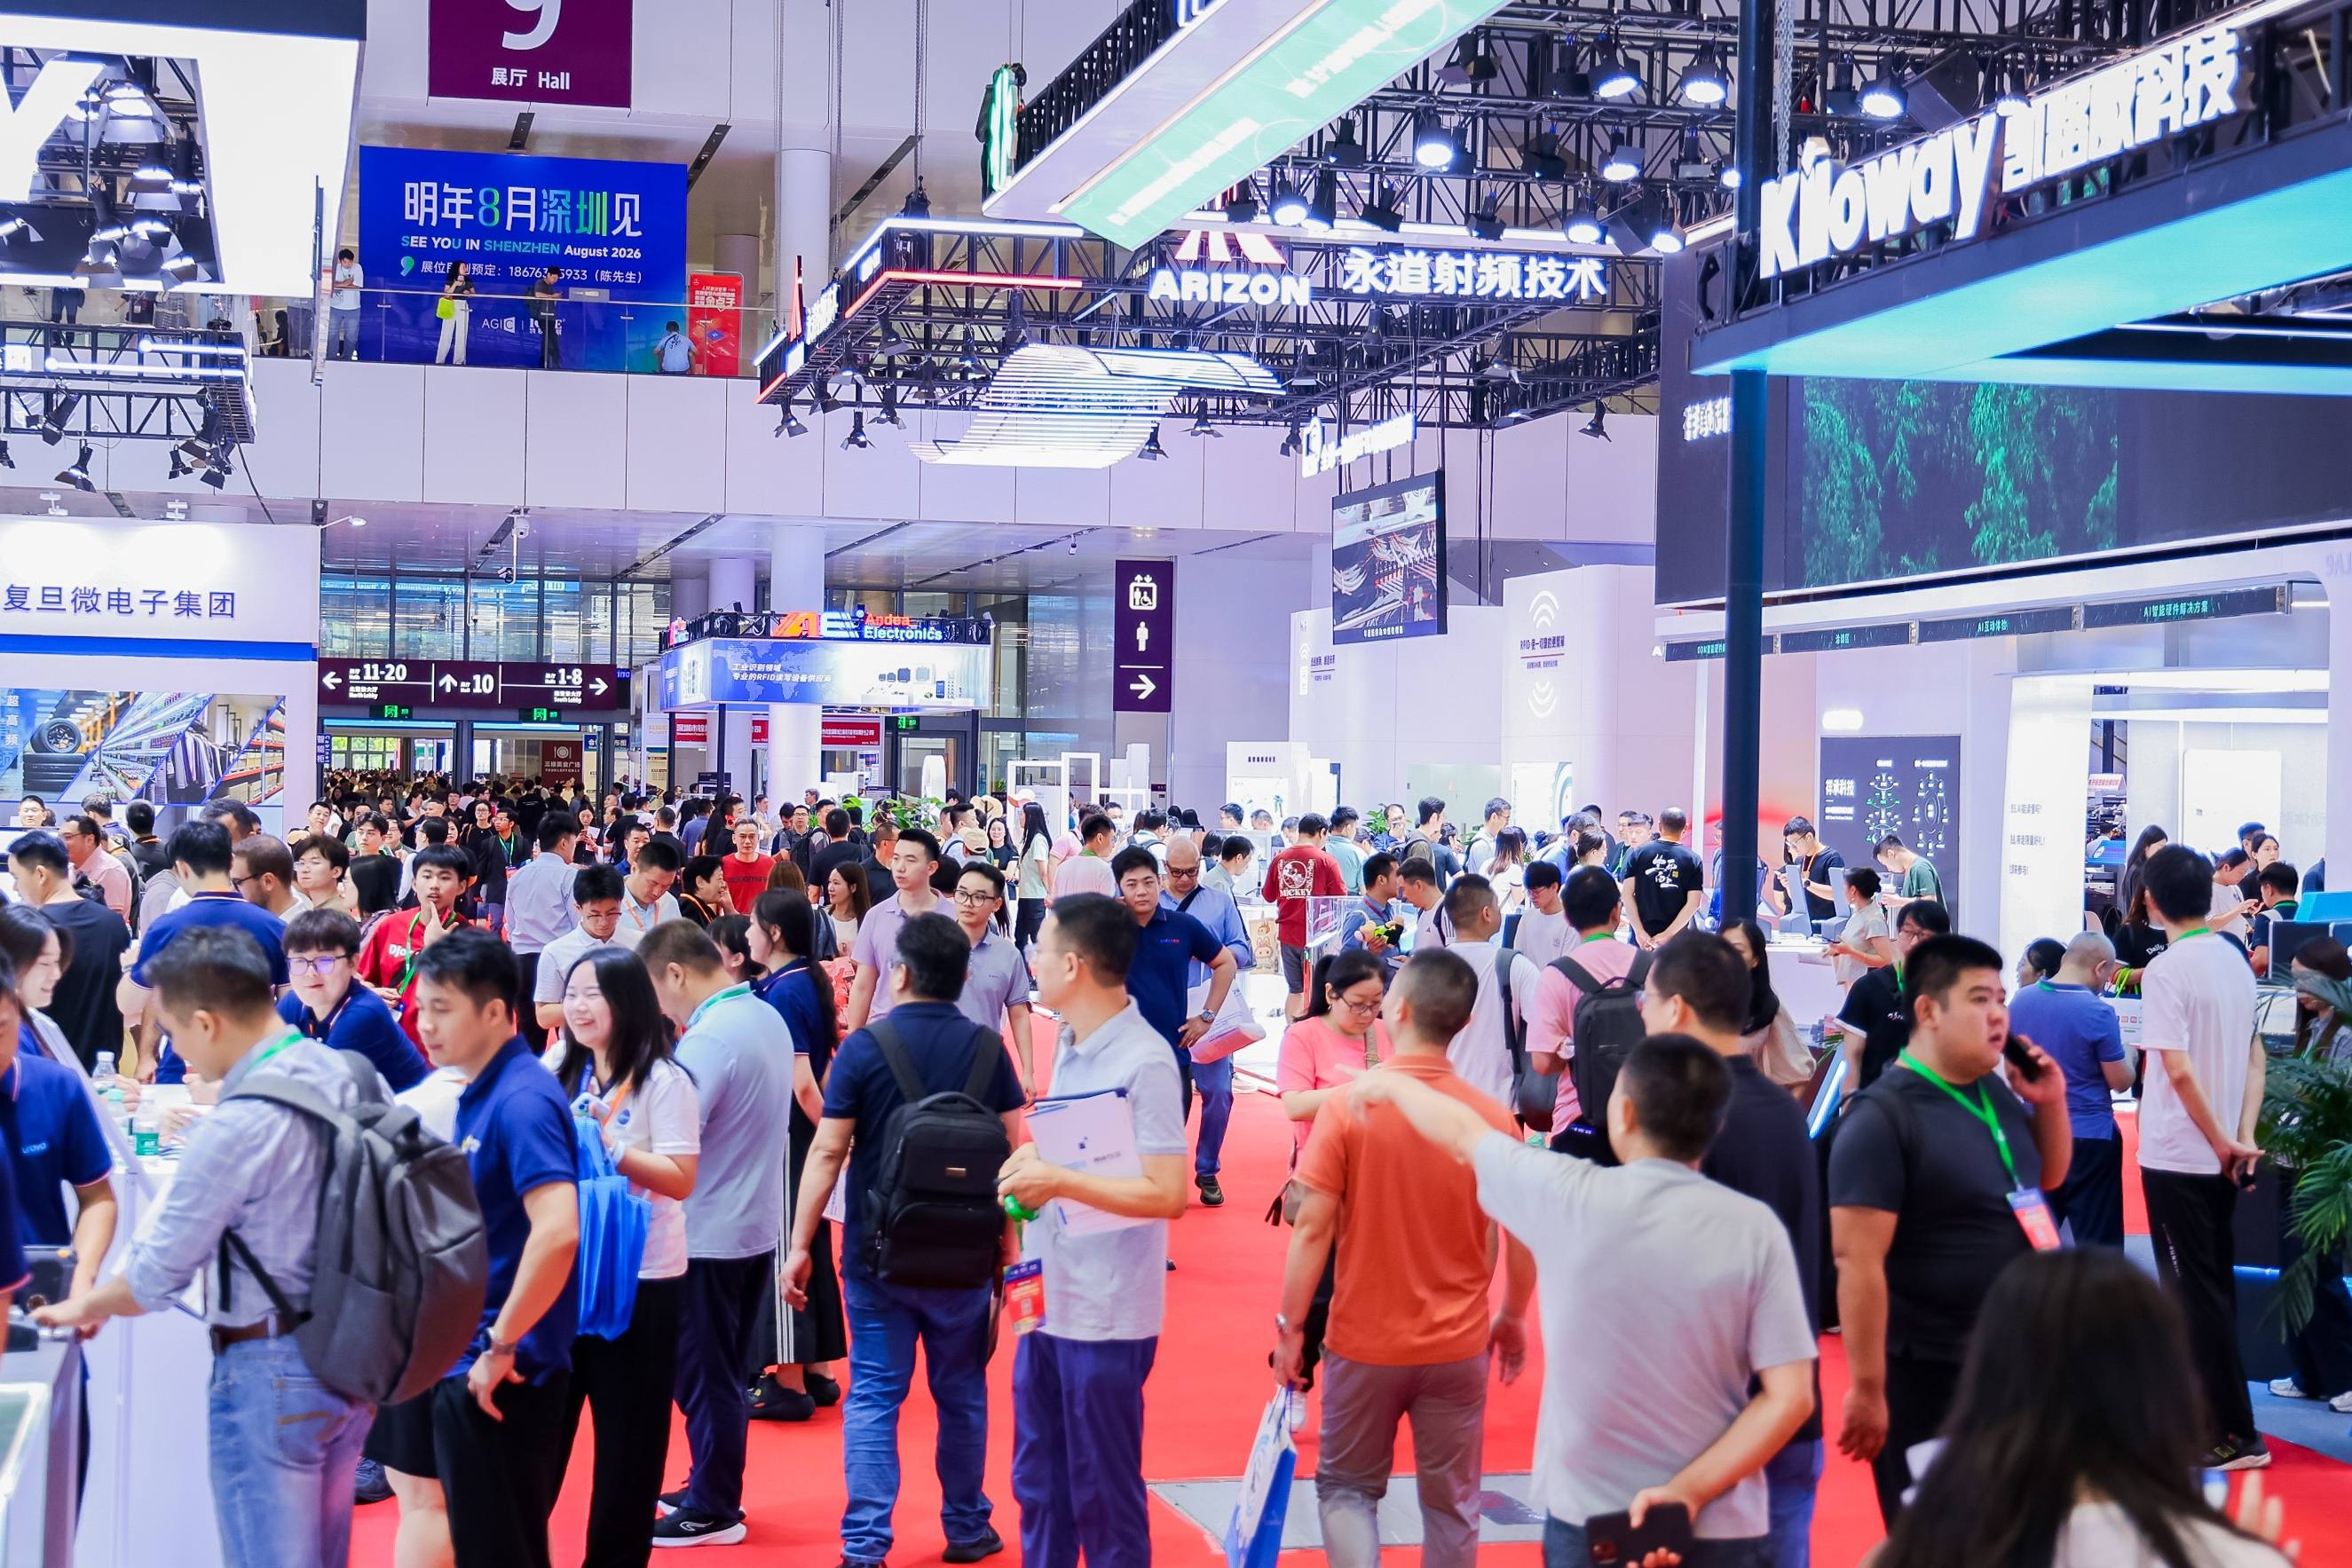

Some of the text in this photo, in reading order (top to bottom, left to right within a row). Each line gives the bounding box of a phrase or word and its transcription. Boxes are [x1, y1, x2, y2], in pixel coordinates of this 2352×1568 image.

[491, 67, 570, 90] 展厅 Hall
[404, 181, 643, 238] 明年8月深圳见
[401, 235, 642, 259] SEE YOU IN SHENZHEN August 2026
[509, 265, 588, 280] 1867635933
[1342, 247, 1608, 300] 永道射频技术
[1149, 269, 1311, 306] ARIZON
[3, 583, 236, 619] 复旦微电子集团
[864, 613, 911, 626] Andea
[864, 627, 943, 641] Electronics
[363, 663, 407, 681] 11-20
[558, 668, 583, 685] 1-8
[472, 674, 494, 694] 10
[2145, 943, 2165, 955] Daily
